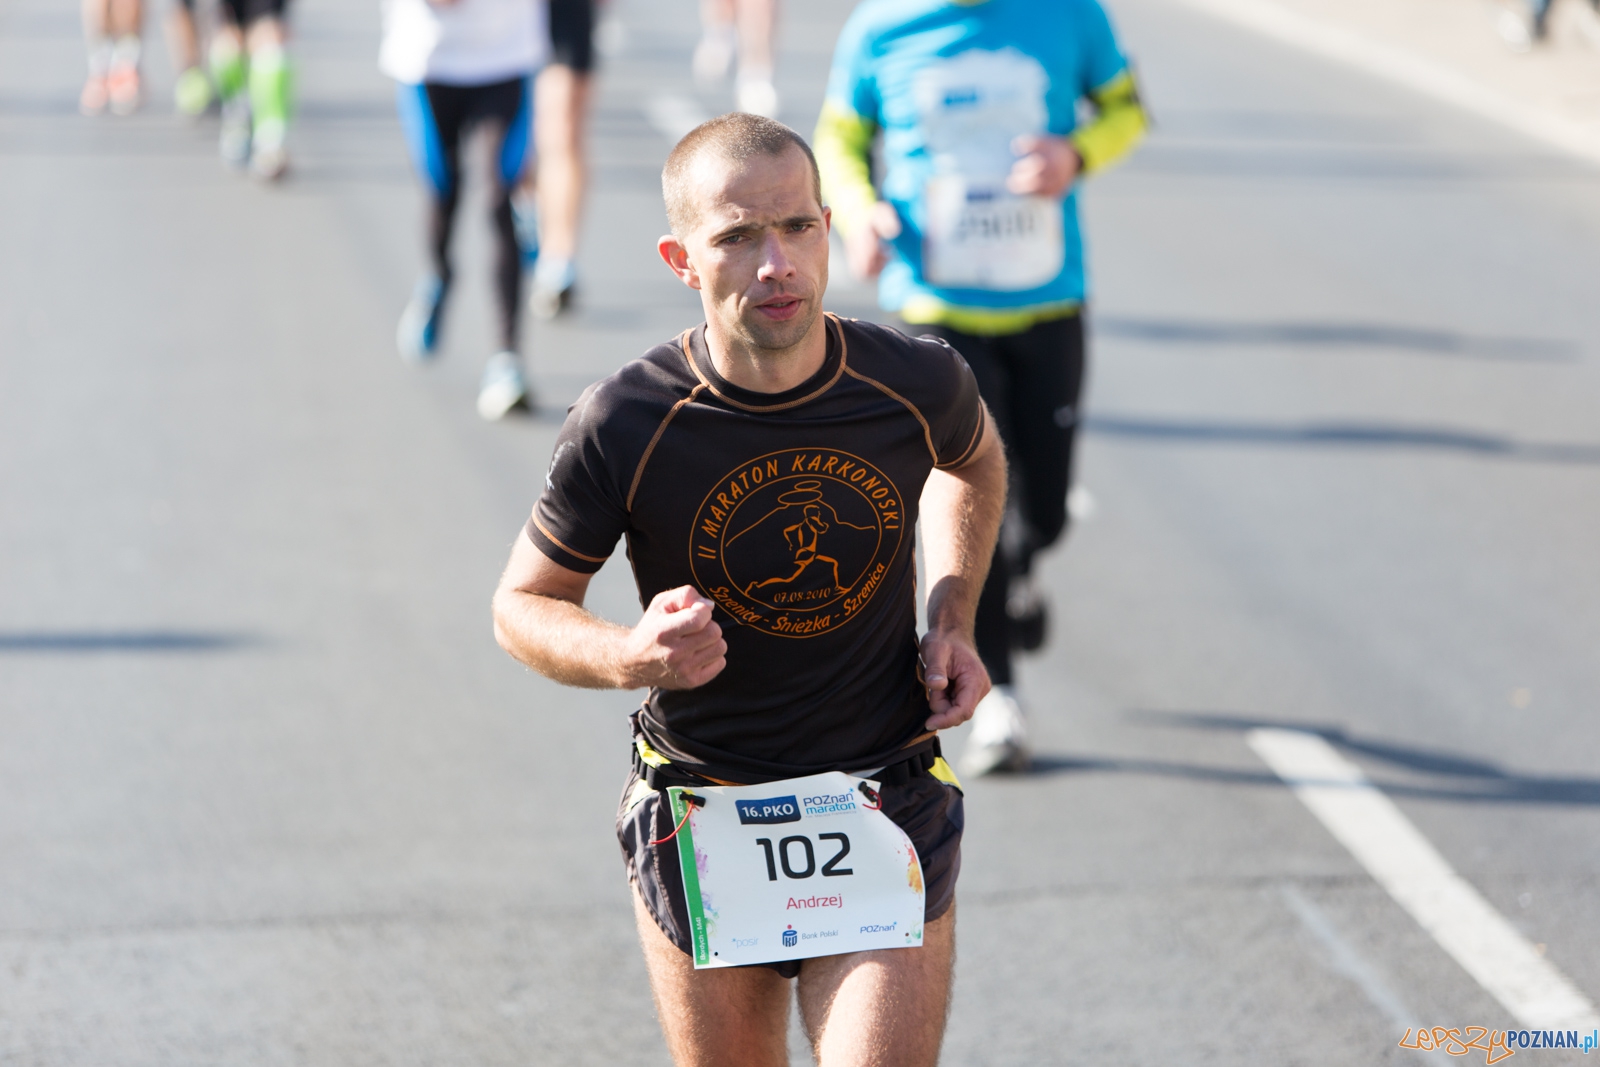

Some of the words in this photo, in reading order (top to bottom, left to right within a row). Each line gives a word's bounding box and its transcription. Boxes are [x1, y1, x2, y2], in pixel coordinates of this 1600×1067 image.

[701, 459, 779, 539] MARATON
[791, 454, 899, 530] KARKONOSKI
[709, 586, 763, 623] Szrenica
[843, 562, 885, 616] Szrenica
[773, 587, 831, 603] 07.08.2010
[805, 802, 856, 815] maraton
[756, 832, 854, 881] 102
[786, 893, 843, 910] Andrzej
[820, 930, 839, 938] Polski
